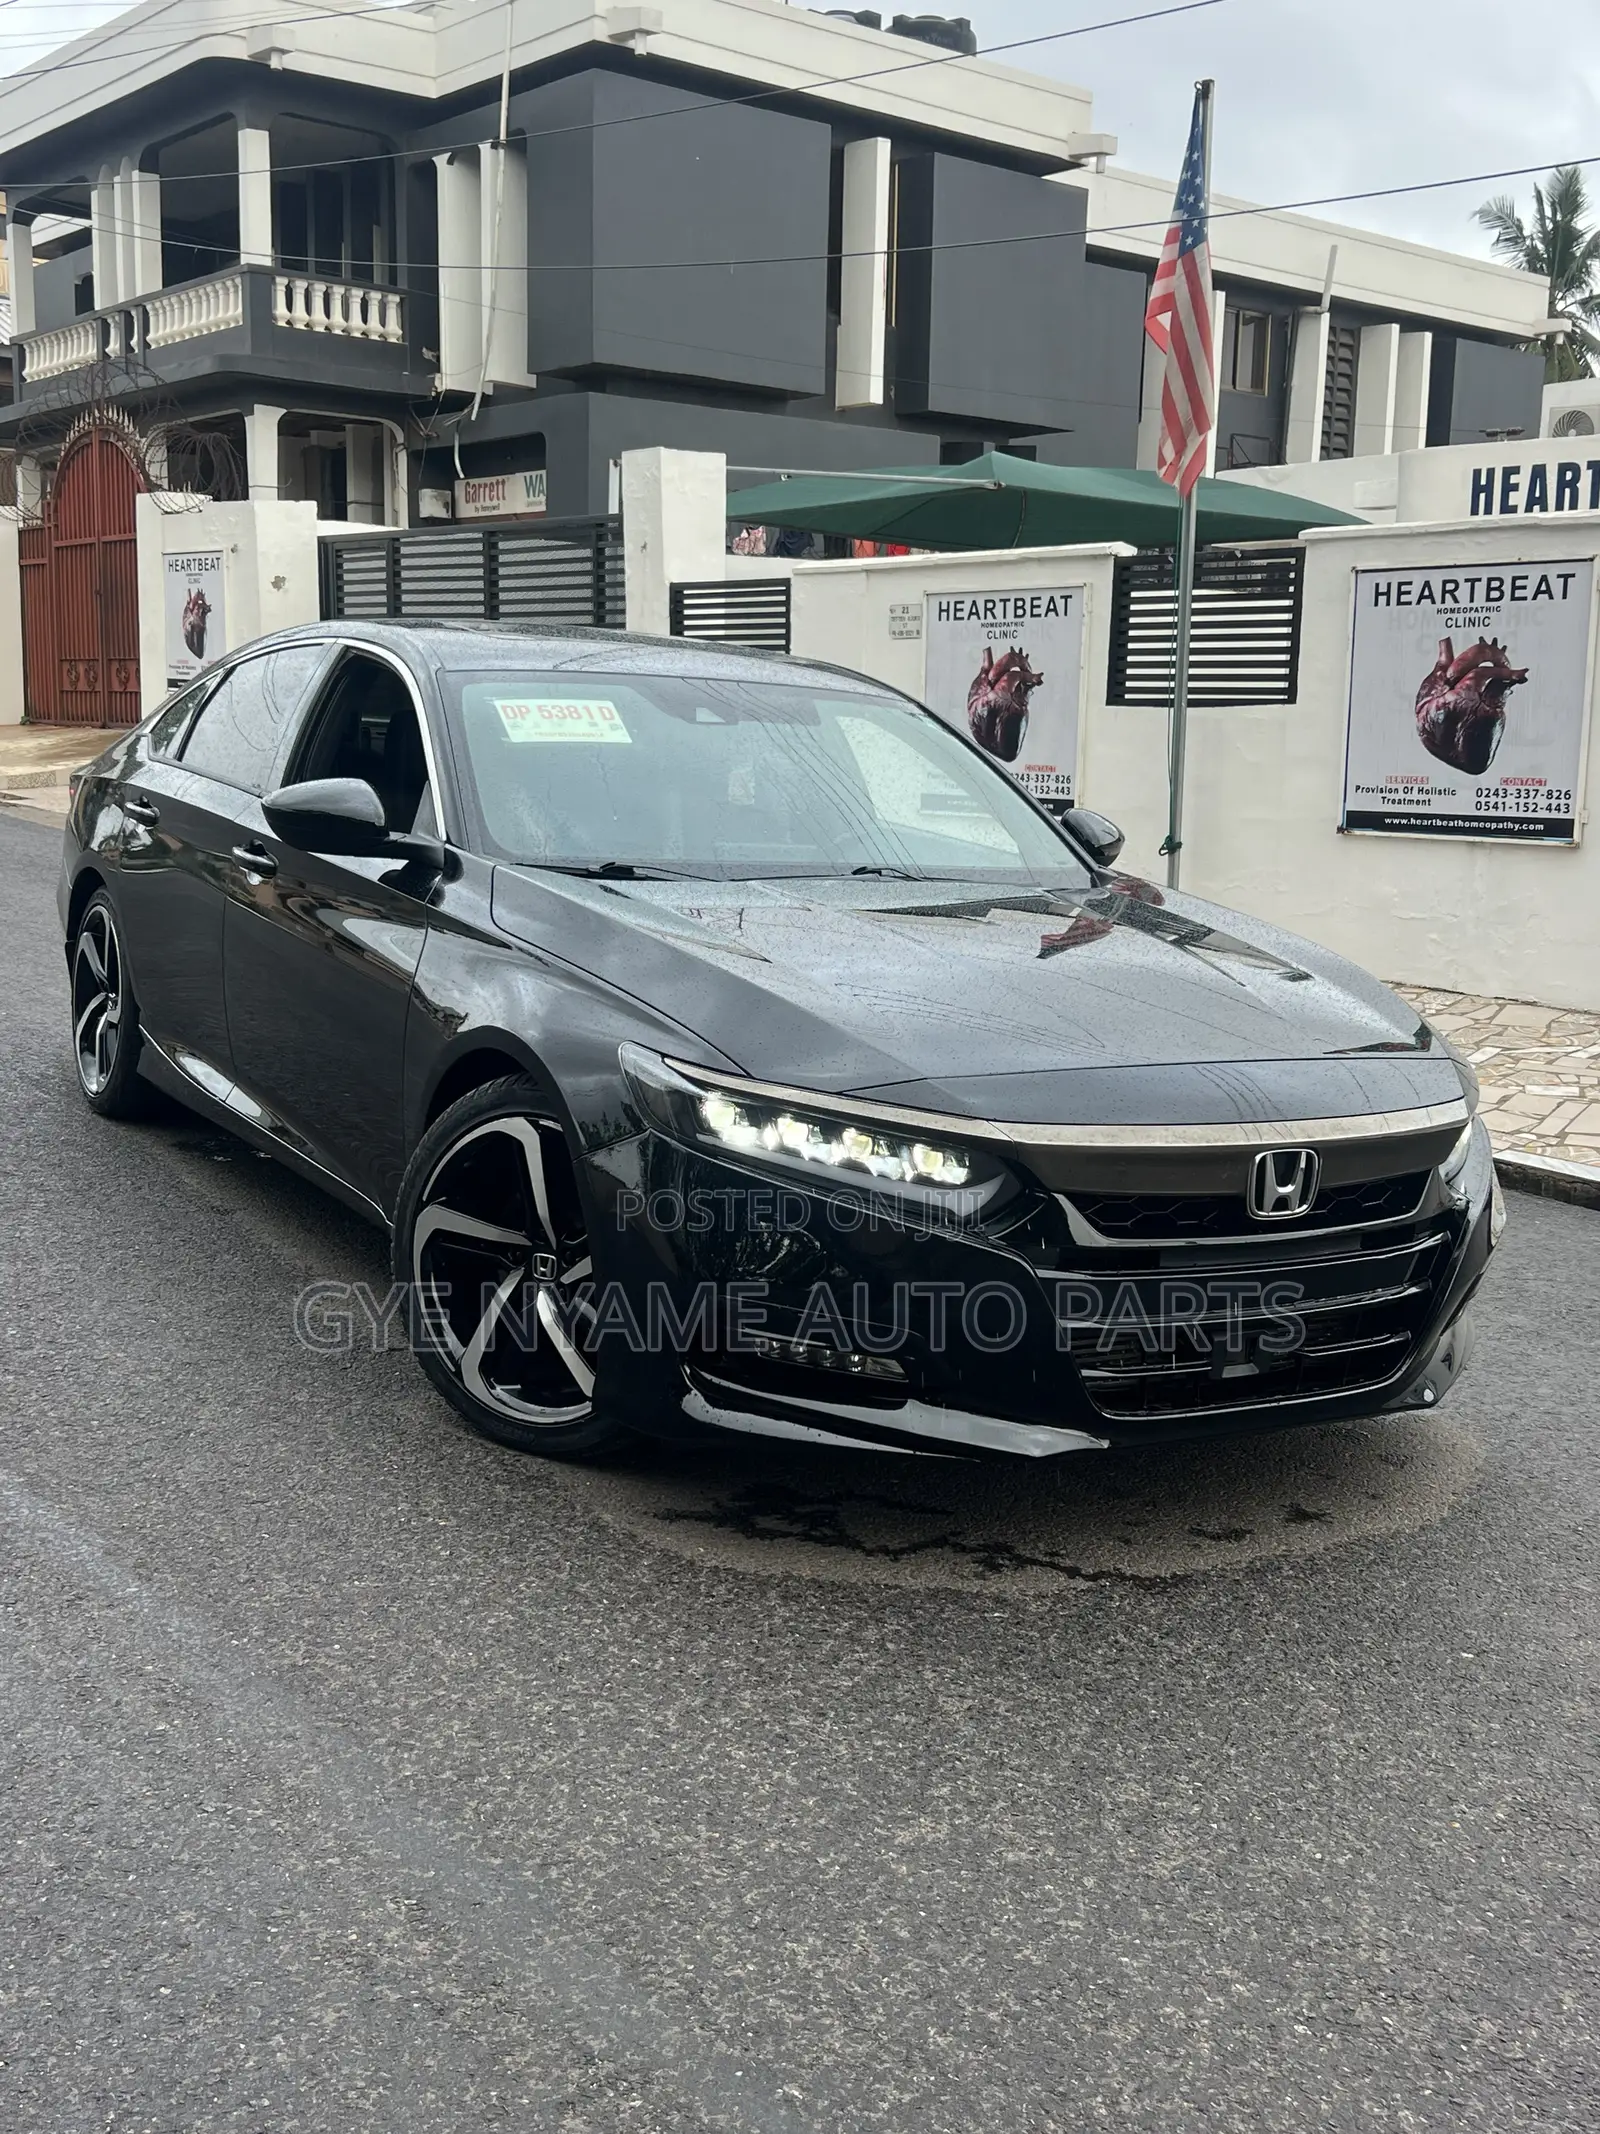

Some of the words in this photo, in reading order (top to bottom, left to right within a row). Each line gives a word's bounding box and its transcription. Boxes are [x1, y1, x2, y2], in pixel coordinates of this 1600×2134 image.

[465, 478, 506, 504] Garrett
[524, 473, 546, 498] WA
[1470, 459, 1600, 516] HEART
[168, 557, 221, 572] HEARTBEAT
[1373, 573, 1576, 607] HEARTBEAT
[938, 595, 1072, 621] HEARTBEAT
[1436, 606, 1502, 615] HOMEOPATHIC
[1445, 616, 1491, 629] CLINIC
[986, 630, 1018, 640] CLINIC
[500, 704, 531, 720] DP
[536, 704, 595, 720] 5381
[597, 705, 616, 721] D
[1386, 776, 1428, 784] SERVICES
[1500, 777, 1547, 786] CONTACT
[1355, 785, 1399, 795] Provision
[1402, 786, 1414, 796] Of
[1417, 786, 1457, 796] Holistic
[1476, 787, 1572, 800] 0243-337-826
[1381, 796, 1431, 806] Treatment
[1475, 801, 1571, 814] 0541-152-443
[1384, 817, 1544, 831] www.heartbeathomeopathy.com
